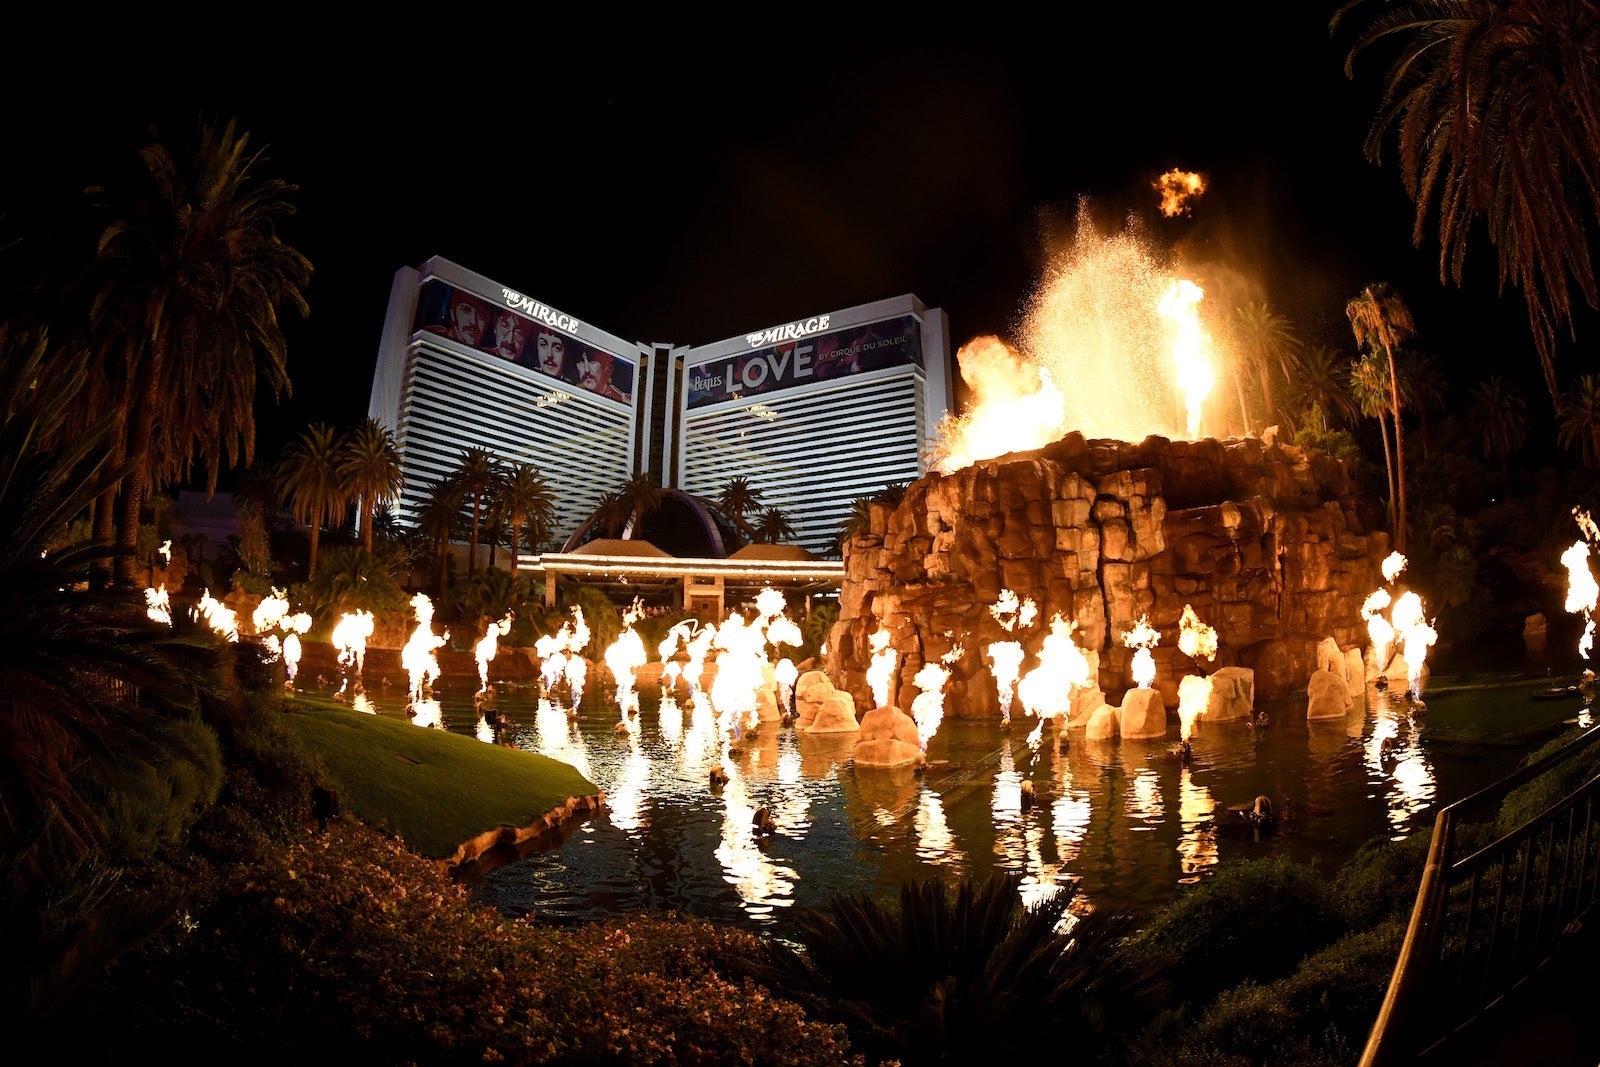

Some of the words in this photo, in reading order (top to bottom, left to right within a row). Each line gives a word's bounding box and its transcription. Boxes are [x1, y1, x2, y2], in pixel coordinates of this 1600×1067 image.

[502, 288, 520, 303] THE
[506, 297, 579, 334] MIRAGE
[746, 332, 764, 344] THE
[751, 315, 830, 348] MIRAGE
[818, 352, 829, 361] BY
[830, 345, 861, 358] CIRQUE
[863, 342, 876, 352] DU
[877, 335, 907, 348] SOLEIL
[726, 345, 814, 393] LOVE
[694, 375, 722, 391] BEATLES
